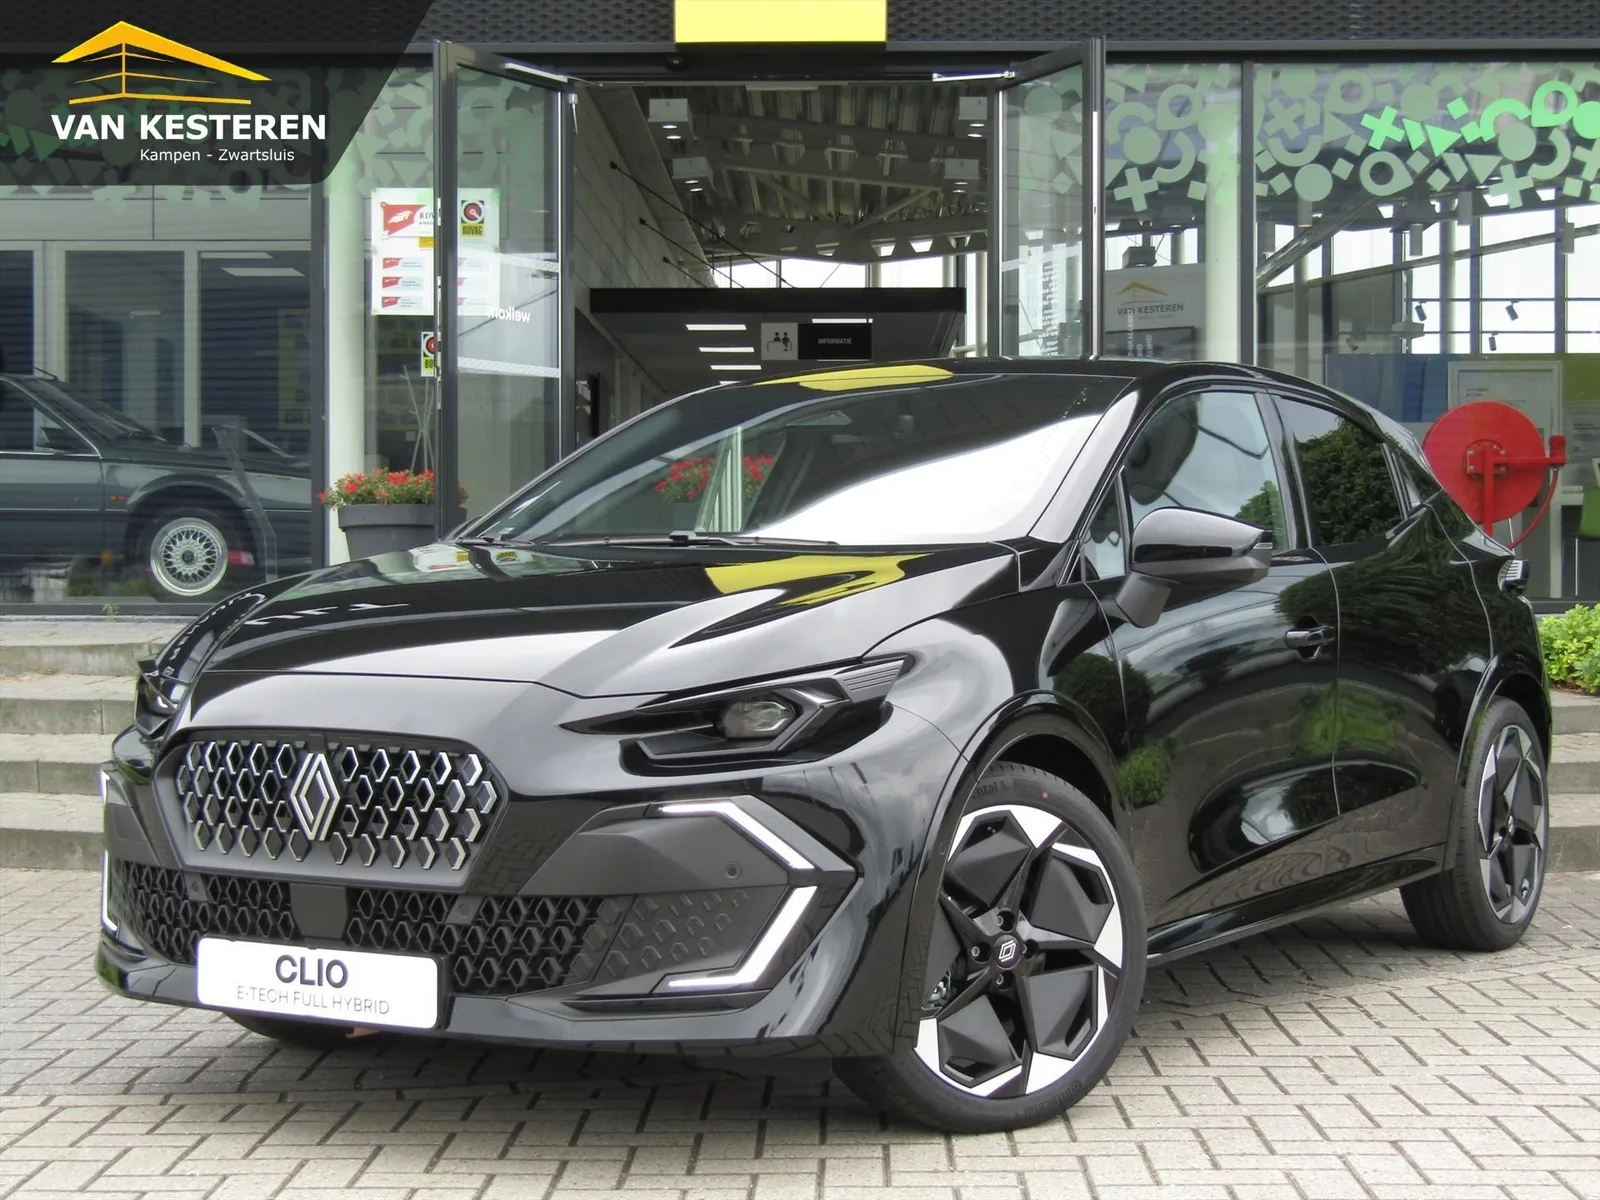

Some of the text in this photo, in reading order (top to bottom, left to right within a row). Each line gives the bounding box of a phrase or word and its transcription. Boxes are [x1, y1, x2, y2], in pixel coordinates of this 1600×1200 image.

[462, 225, 483, 236] BOVAG
[1117, 303, 1184, 316] VAN KESTEREN
[275, 954, 349, 989] CLIO
[237, 986, 390, 1015] E-TECH FULL HYBRID
